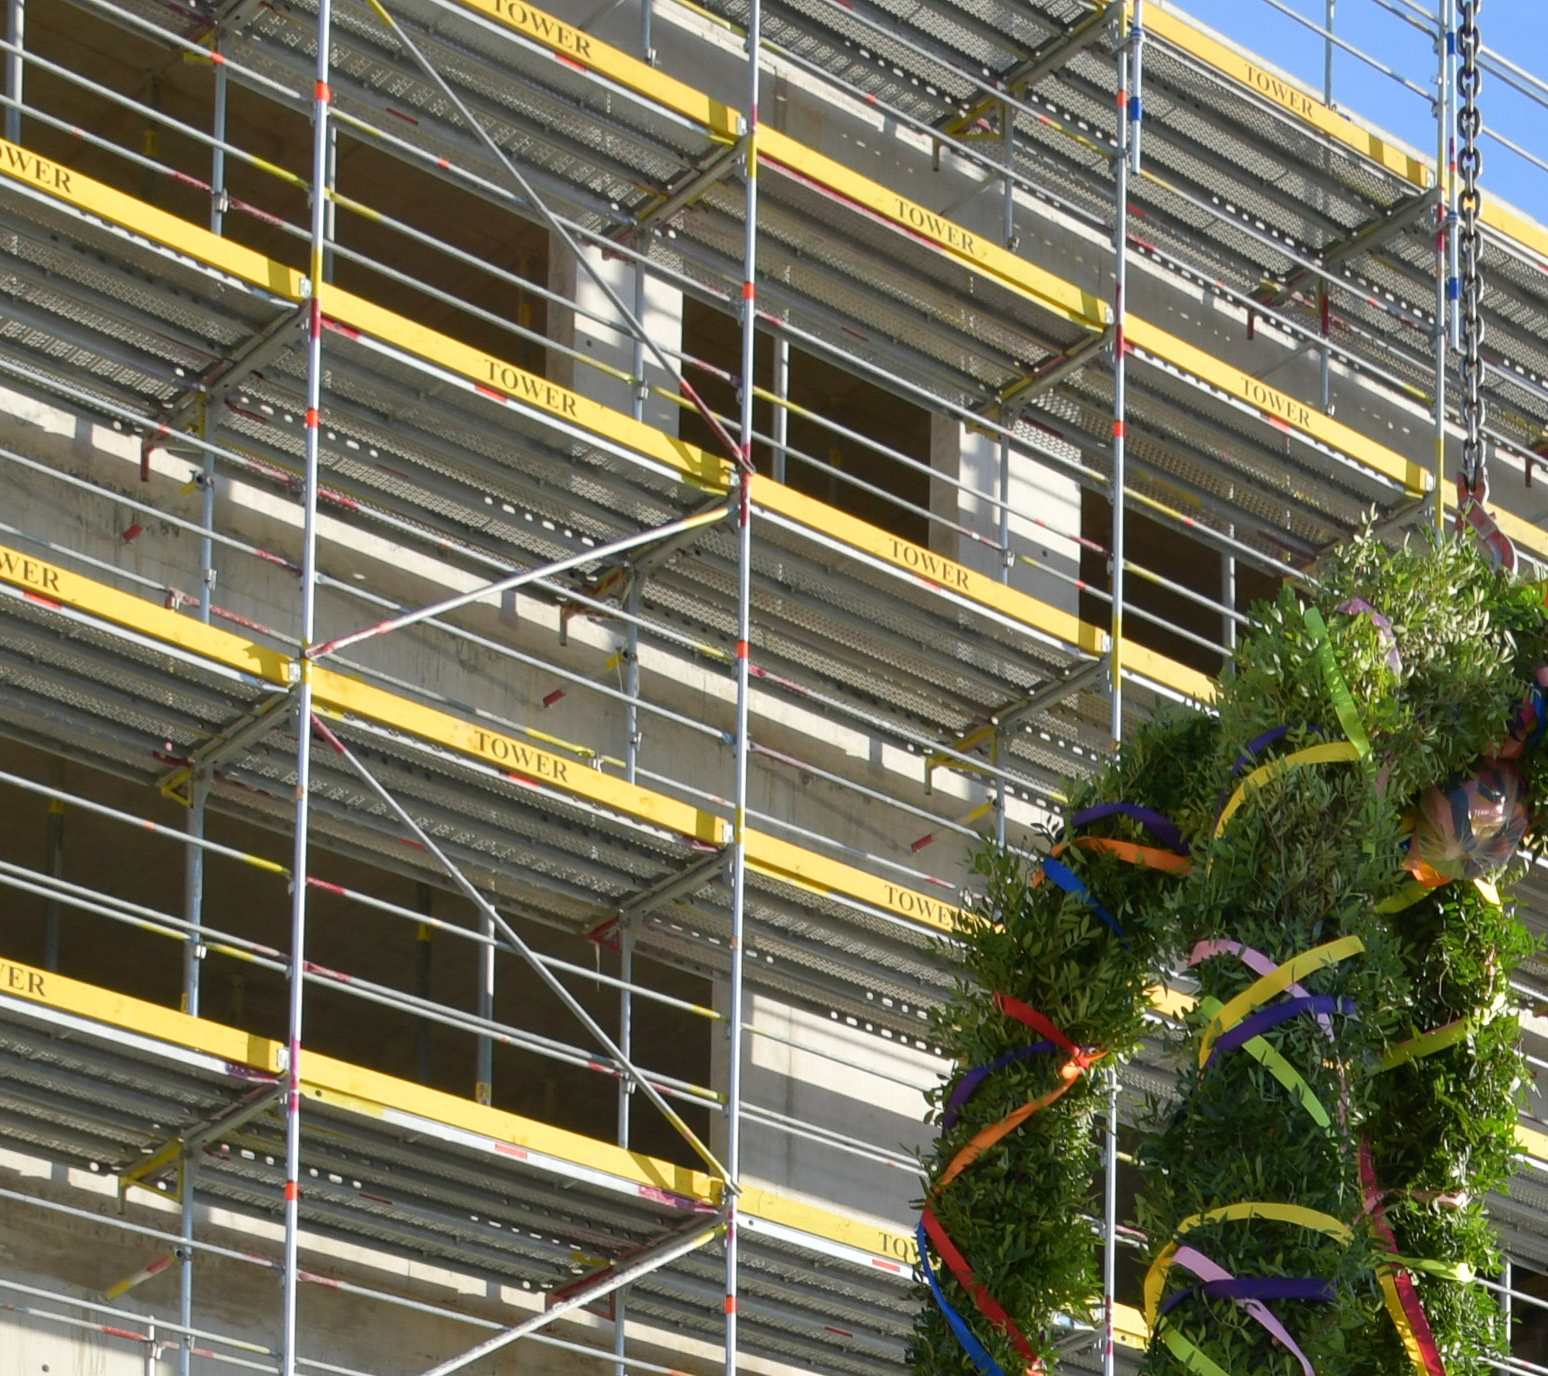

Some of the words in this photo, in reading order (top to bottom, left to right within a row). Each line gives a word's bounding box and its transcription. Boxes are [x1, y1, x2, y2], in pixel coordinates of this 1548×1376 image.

[493, 0, 591, 60] TOWER
[1245, 64, 1316, 117] TOWER
[895, 198, 976, 256] TOWER
[485, 358, 578, 418] TOWER
[1242, 377, 1312, 425] TOWER
[888, 537, 971, 589] TOWER
[473, 730, 568, 782] TOWER
[882, 883, 962, 931] TOWE
